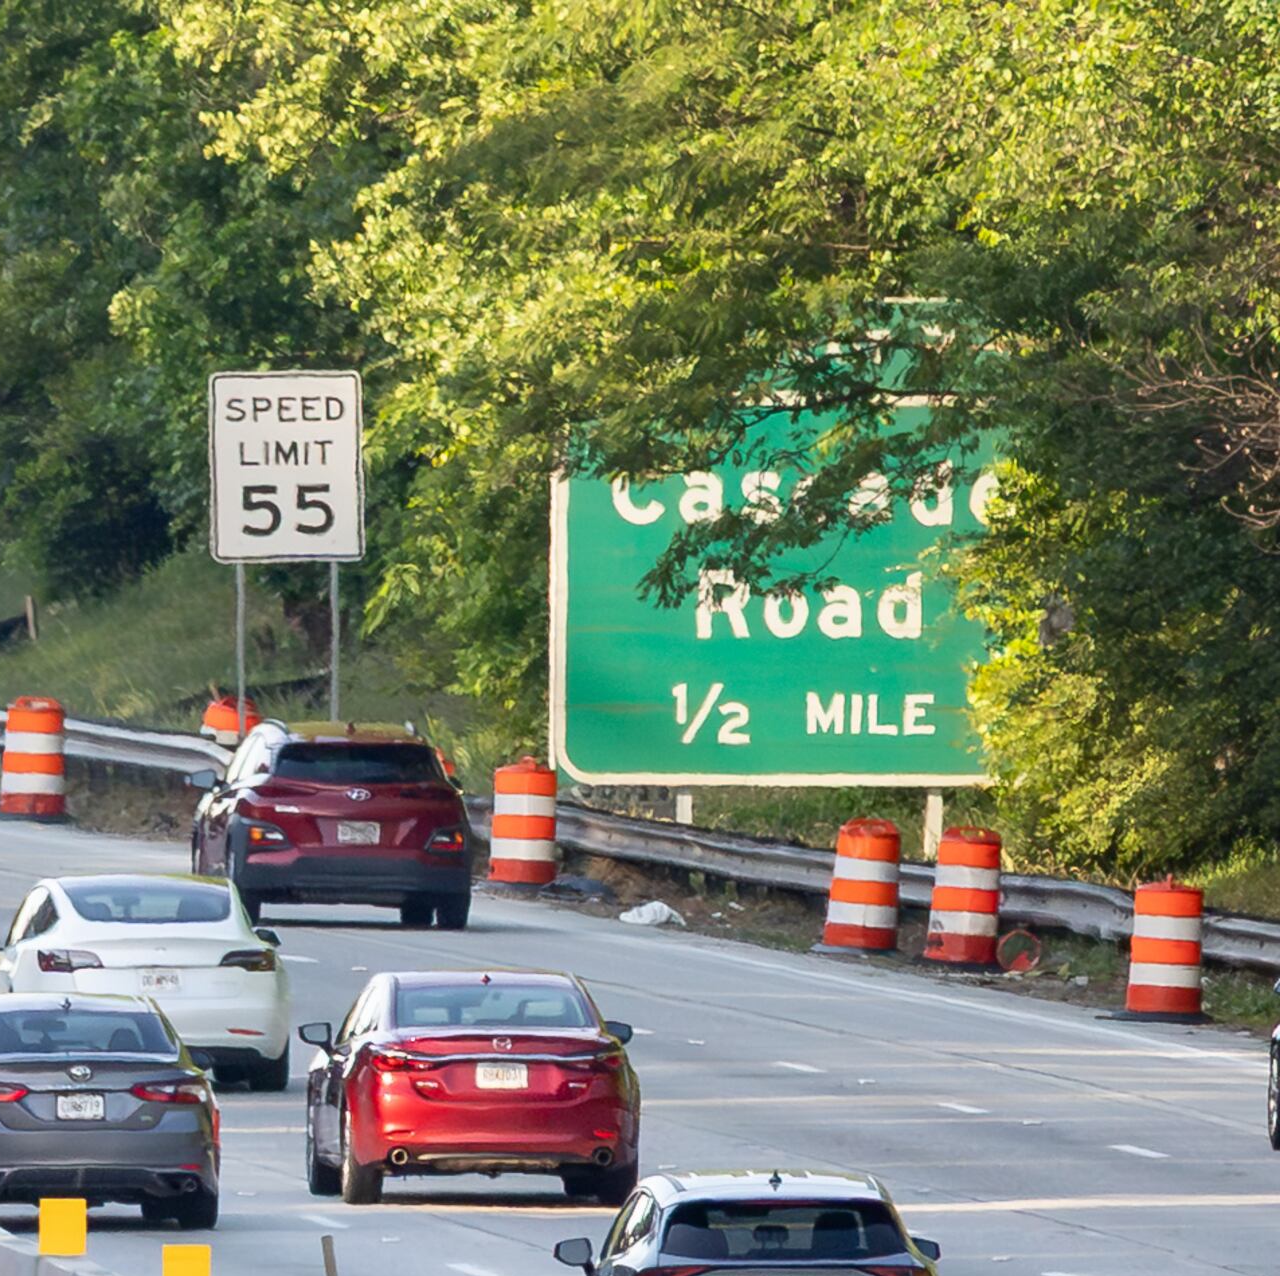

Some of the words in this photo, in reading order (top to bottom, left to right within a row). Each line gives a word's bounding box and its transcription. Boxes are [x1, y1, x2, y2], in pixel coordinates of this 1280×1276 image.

[225, 396, 345, 423] SPEED
[239, 440, 334, 467] LIMIT
[241, 483, 335, 537] 55
[696, 569, 923, 640] Road
[805, 691, 937, 736] MILE
